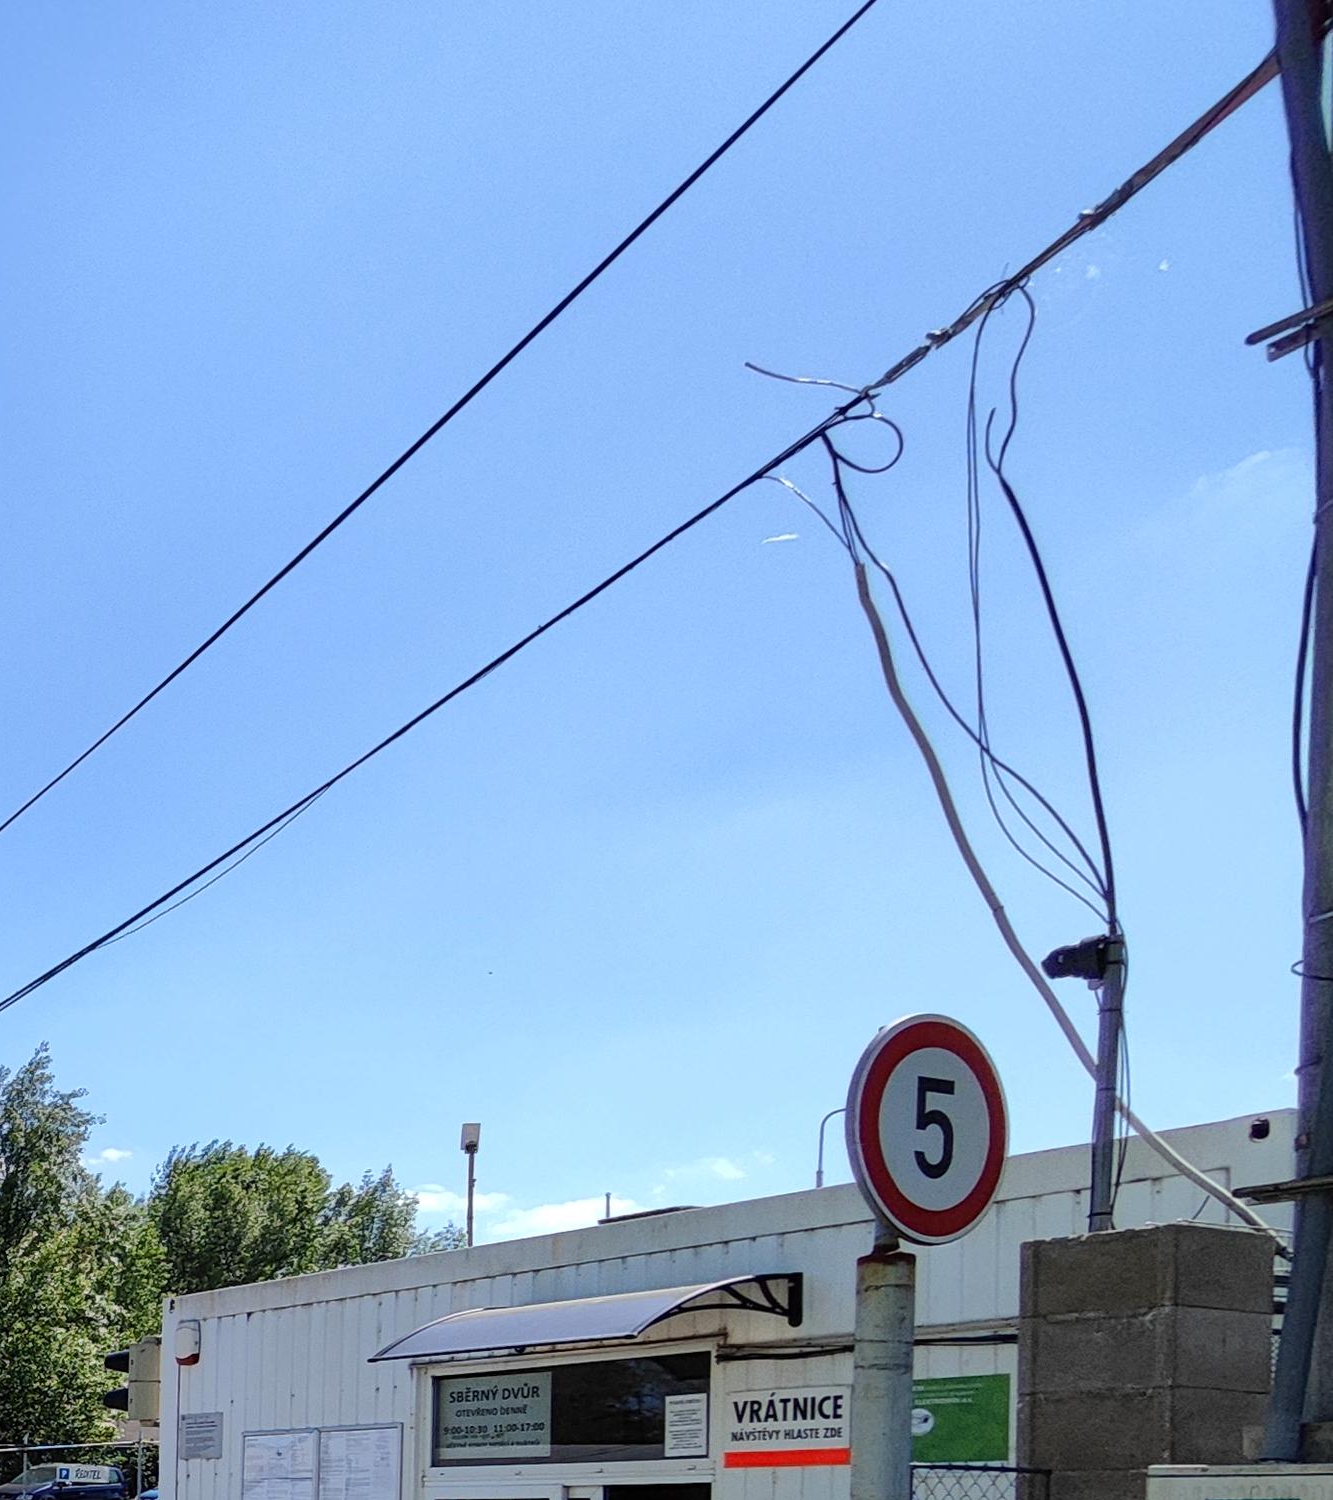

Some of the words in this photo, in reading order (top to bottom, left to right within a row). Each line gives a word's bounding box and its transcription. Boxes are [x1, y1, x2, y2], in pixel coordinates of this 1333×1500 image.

[913, 1076, 955, 1179] 5
[449, 1385, 498, 1403] SBĚRNÝ
[502, 1383, 540, 1400] DVŮR
[733, 1392, 843, 1423] VRÁTNICE
[731, 1428, 780, 1442] NÁVŠTĚVY
[784, 1428, 820, 1440] HLASTE
[823, 1427, 843, 1439] ZDE
